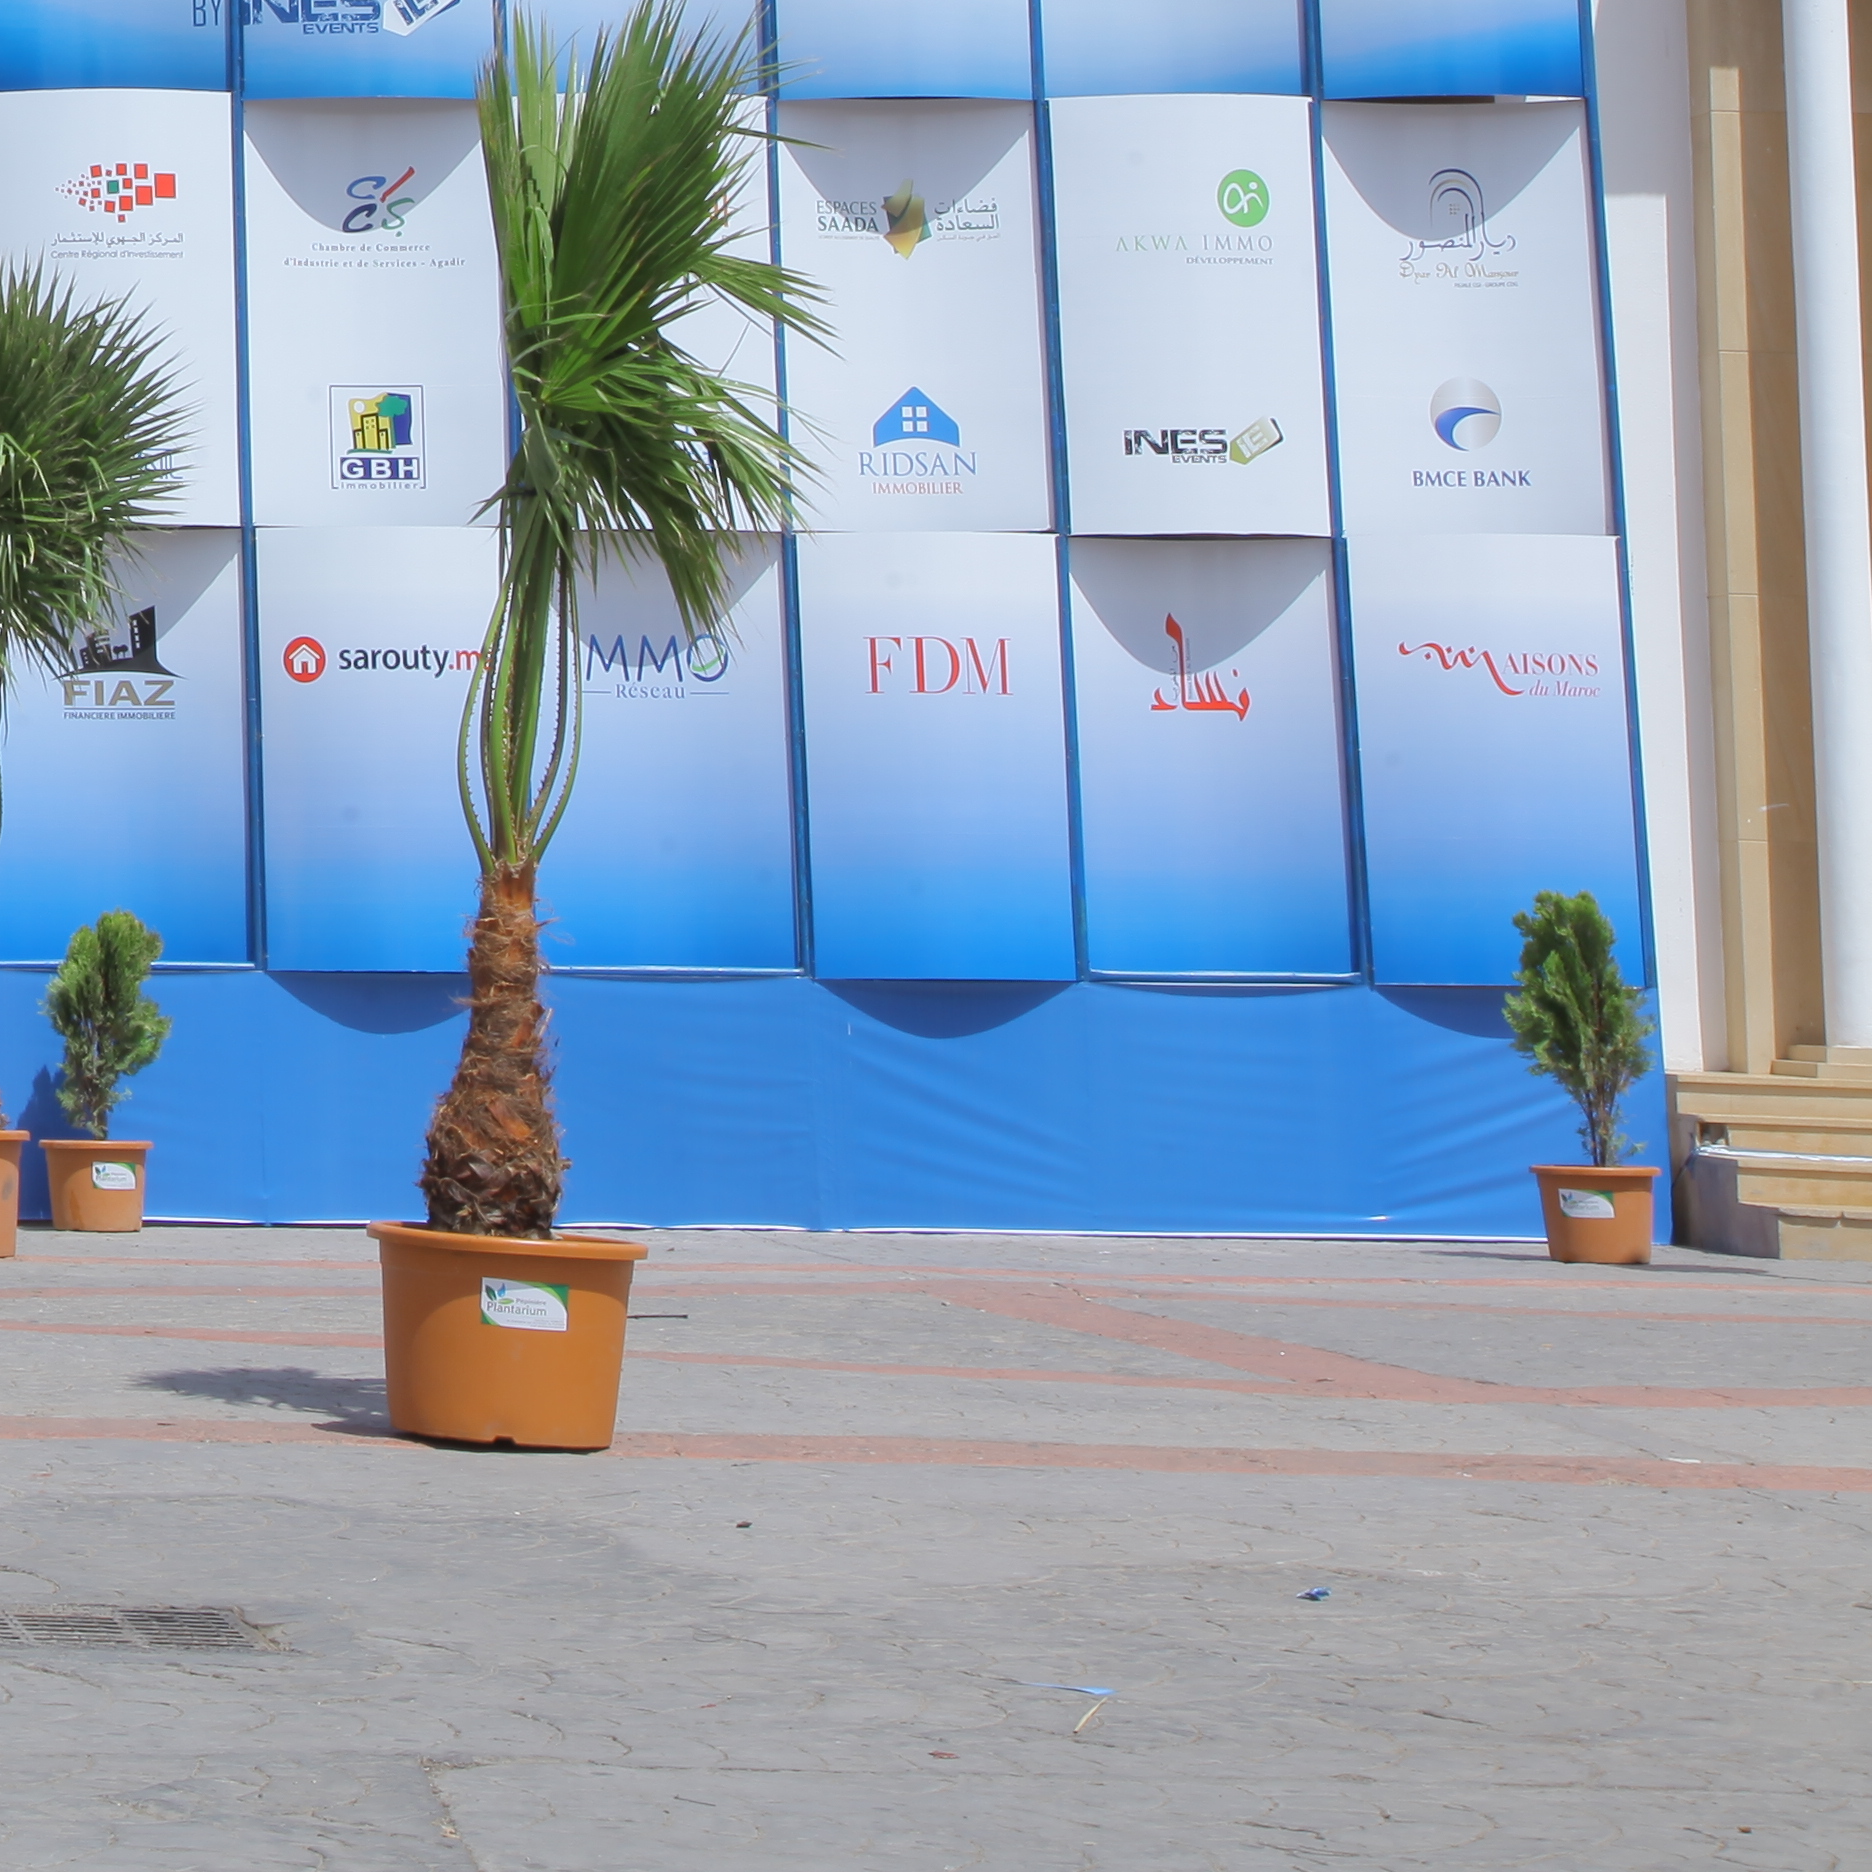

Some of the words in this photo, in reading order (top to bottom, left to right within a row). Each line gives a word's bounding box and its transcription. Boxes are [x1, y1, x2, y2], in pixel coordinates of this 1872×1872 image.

[302, 22, 379, 34] EVENTS
[816, 200, 877, 215] ESPACES
[817, 216, 878, 232] SAADA
[311, 242, 356, 252] Chambre
[360, 242, 372, 252] de
[376, 243, 430, 252] Commerce
[1116, 235, 1189, 252] AKWA
[1202, 235, 1273, 252] IMMO
[284, 257, 339, 268] d'Industrie
[373, 259, 417, 268] Services
[429, 258, 466, 269] Agadir
[1123, 429, 1227, 456] INES
[858, 451, 976, 477] RIDSAN
[1172, 455, 1227, 464] EVENTS
[342, 458, 419, 479] GBH
[340, 480, 420, 491] immobilier
[1413, 470, 1468, 487] BMCE
[1473, 470, 1532, 487] BANK
[872, 481, 962, 495] IMMOBILIER
[863, 636, 1014, 696] FDM
[64, 680, 175, 706] FIAZ
[616, 683, 686, 699] Réseau
[1529, 680, 1548, 696] du
[1554, 681, 1600, 697] Maroc
[486, 1301, 547, 1316] Plantarium
